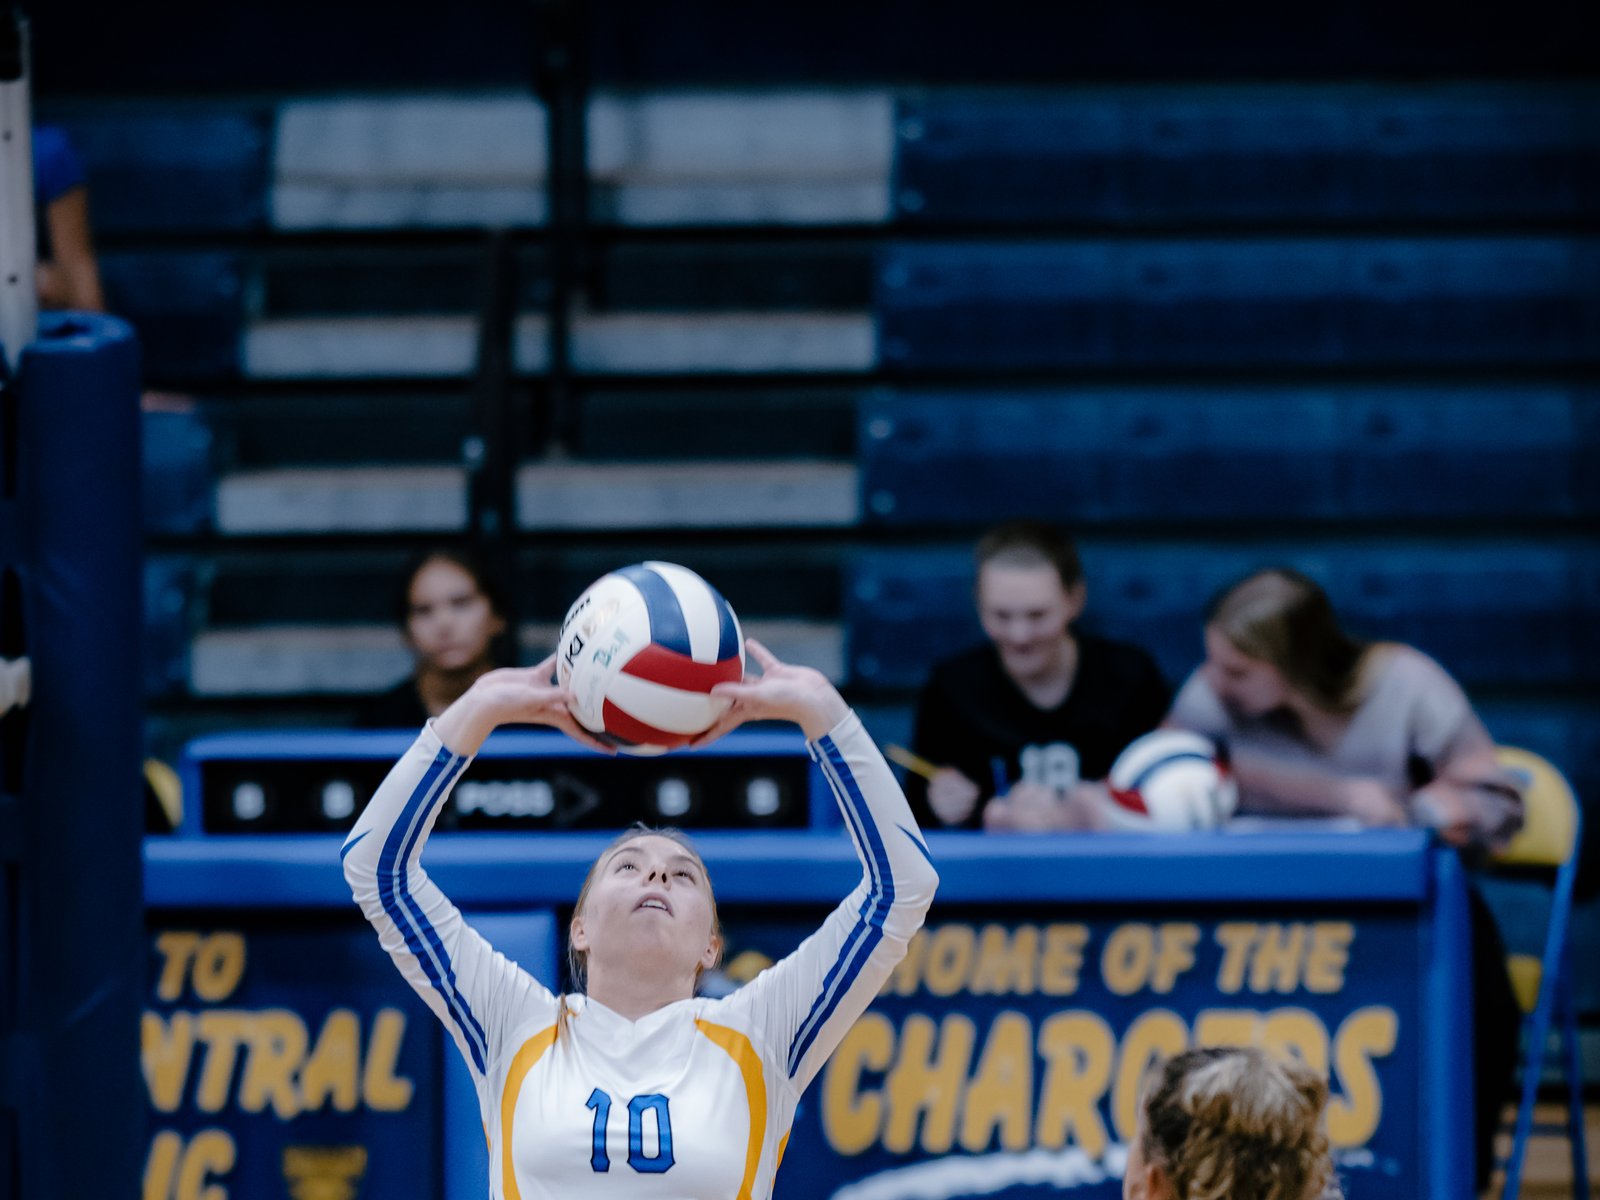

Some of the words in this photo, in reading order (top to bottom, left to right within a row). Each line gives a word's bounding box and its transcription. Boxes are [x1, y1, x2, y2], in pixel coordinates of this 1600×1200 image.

[156, 930, 246, 1002] TO
[1102, 923, 1200, 995] OF
[1214, 922, 1356, 994] THE
[585, 1087, 676, 1174] 10
